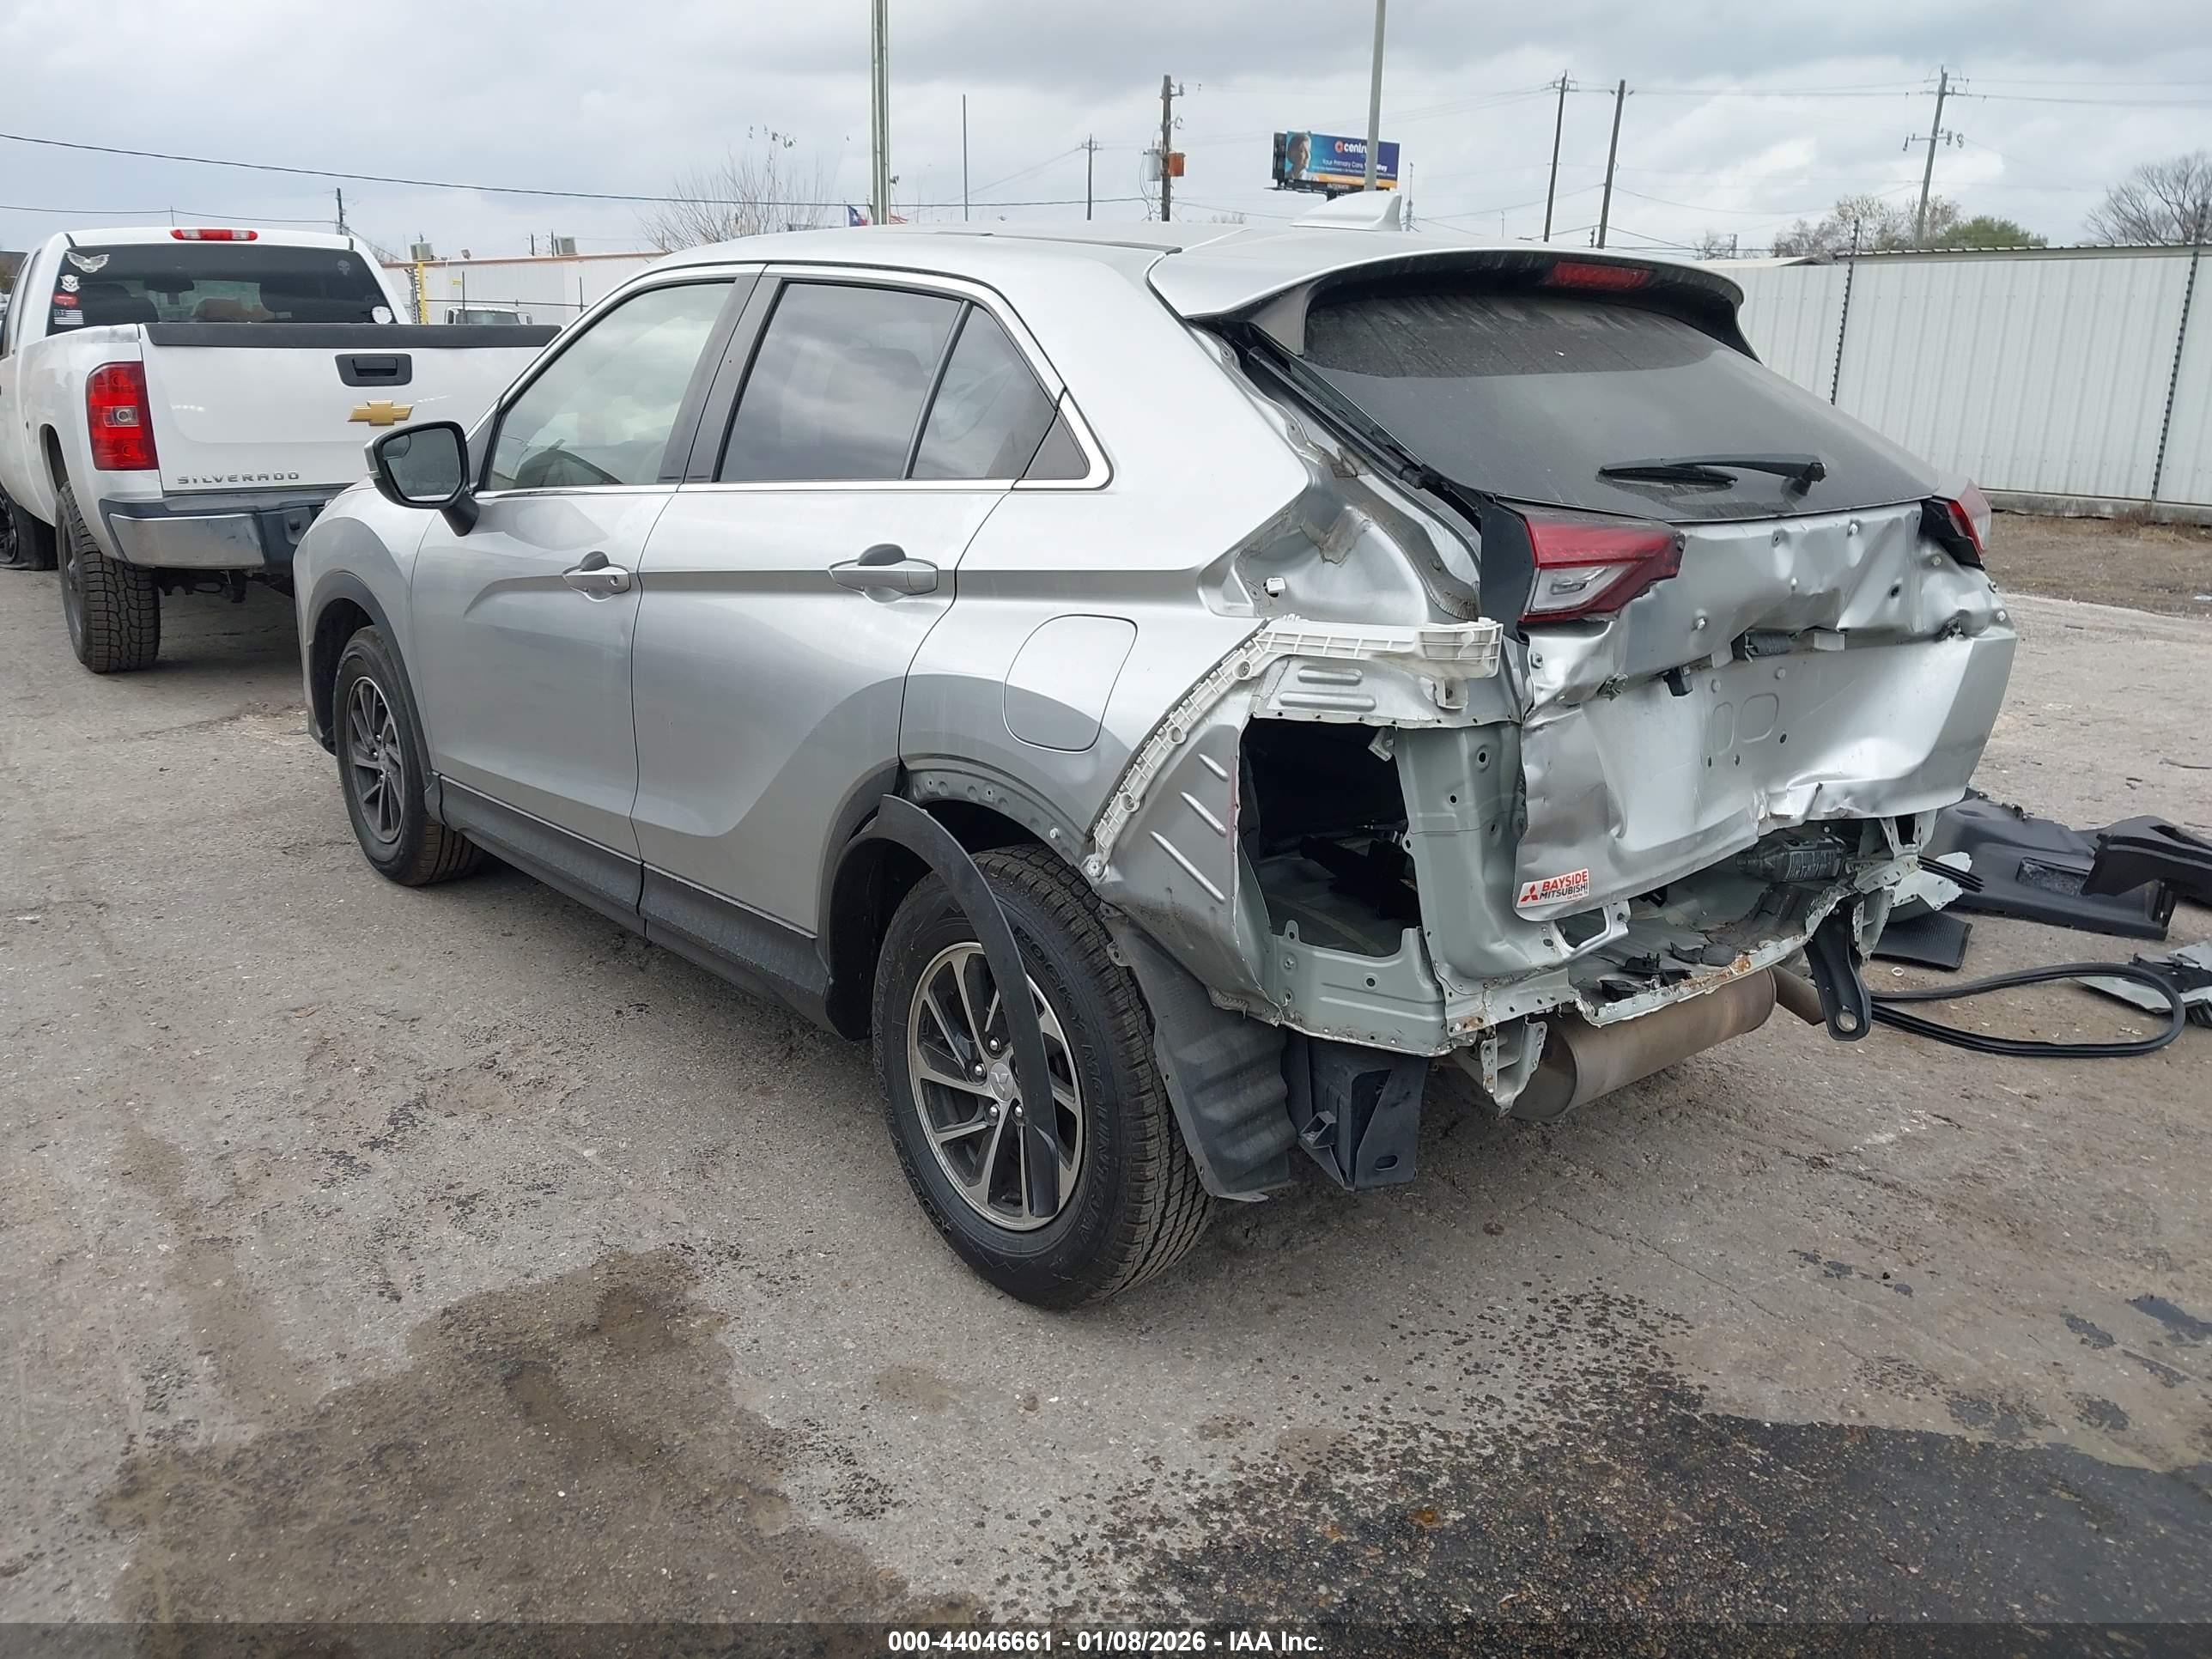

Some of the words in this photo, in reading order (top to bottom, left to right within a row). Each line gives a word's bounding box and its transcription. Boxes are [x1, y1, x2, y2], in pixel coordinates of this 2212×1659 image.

[178, 472, 300, 484] SILVERADO
[1542, 871, 1588, 891] BAYSIDE
[1540, 882, 1588, 900] MITSUBISHI
[1013, 925, 1086, 1030] ROCKY
